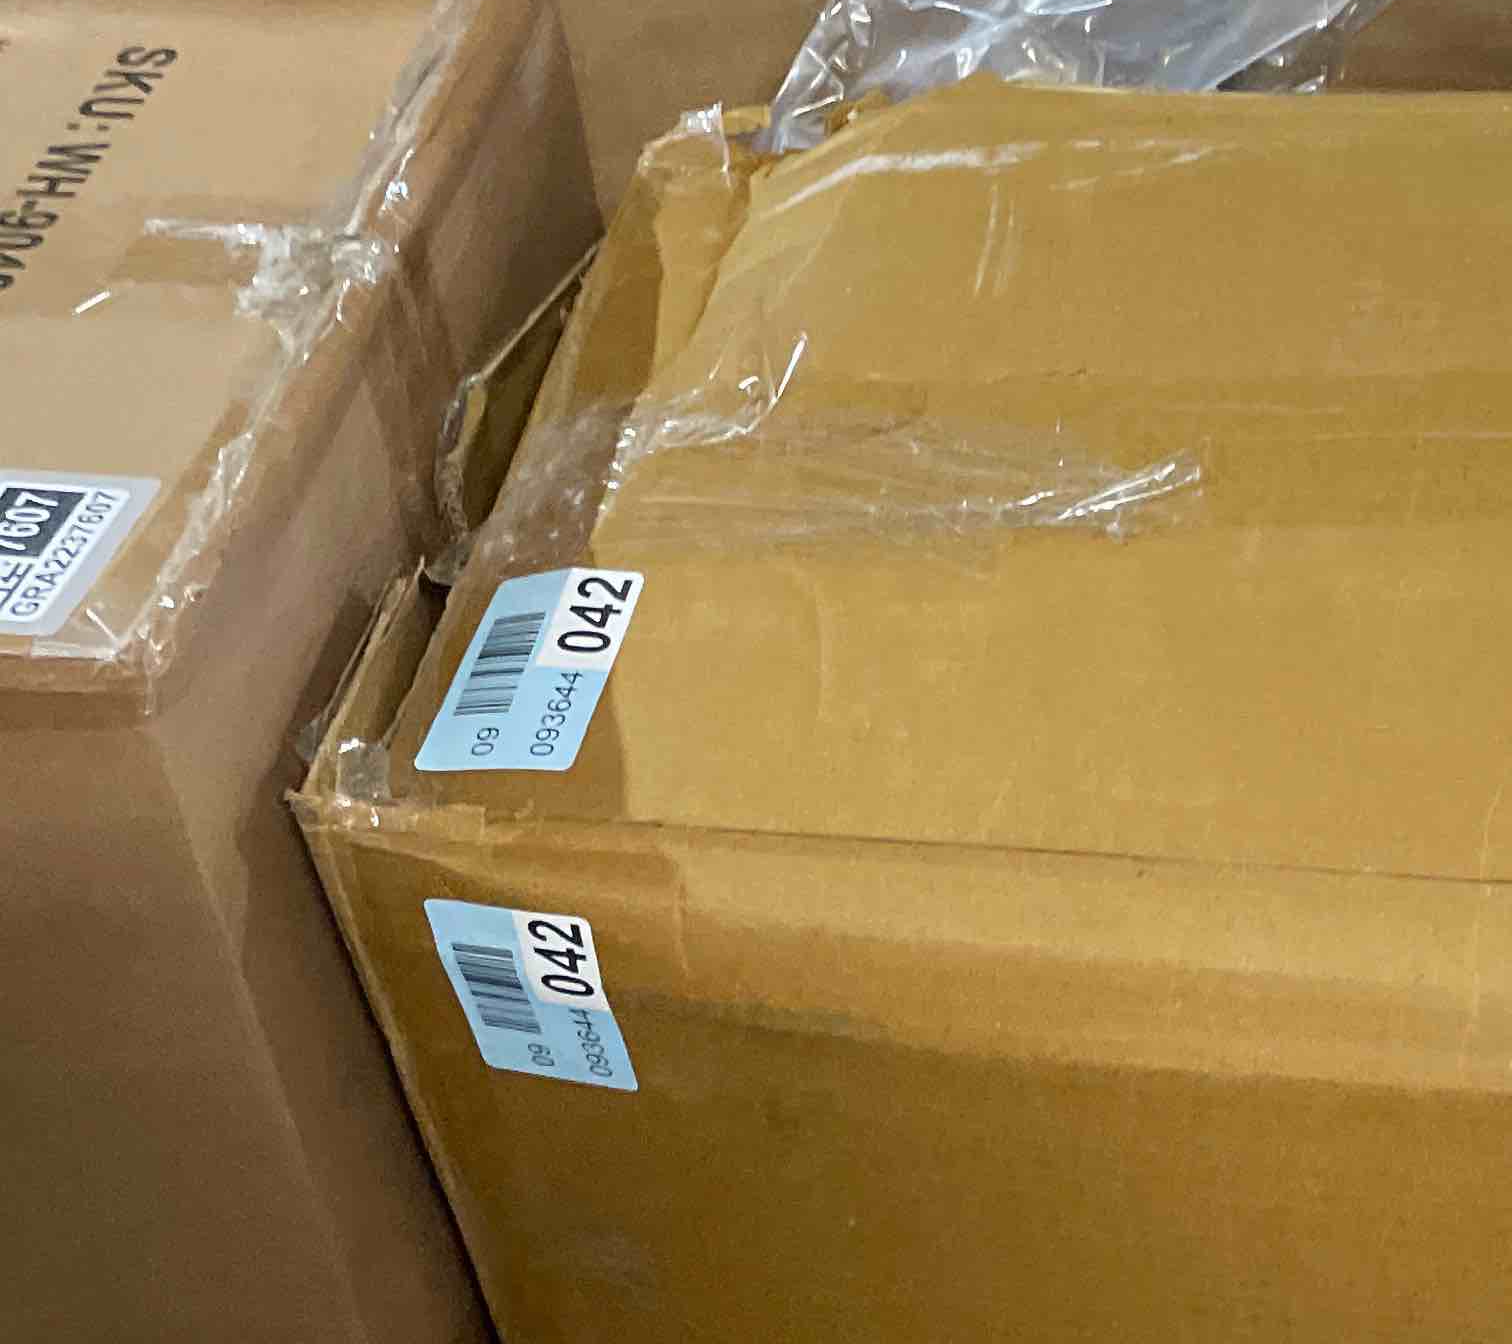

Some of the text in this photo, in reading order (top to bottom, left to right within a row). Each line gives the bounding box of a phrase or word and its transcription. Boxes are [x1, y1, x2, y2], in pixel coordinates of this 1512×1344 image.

[0, 142, 111, 289] WH-90
[10, 491, 118, 616] GRA2237607
[557, 577, 633, 653] 042
[471, 727, 500, 757] 09
[530, 671, 583, 757] 093644
[528, 919, 594, 997] 042
[528, 1043, 556, 1067] 09
